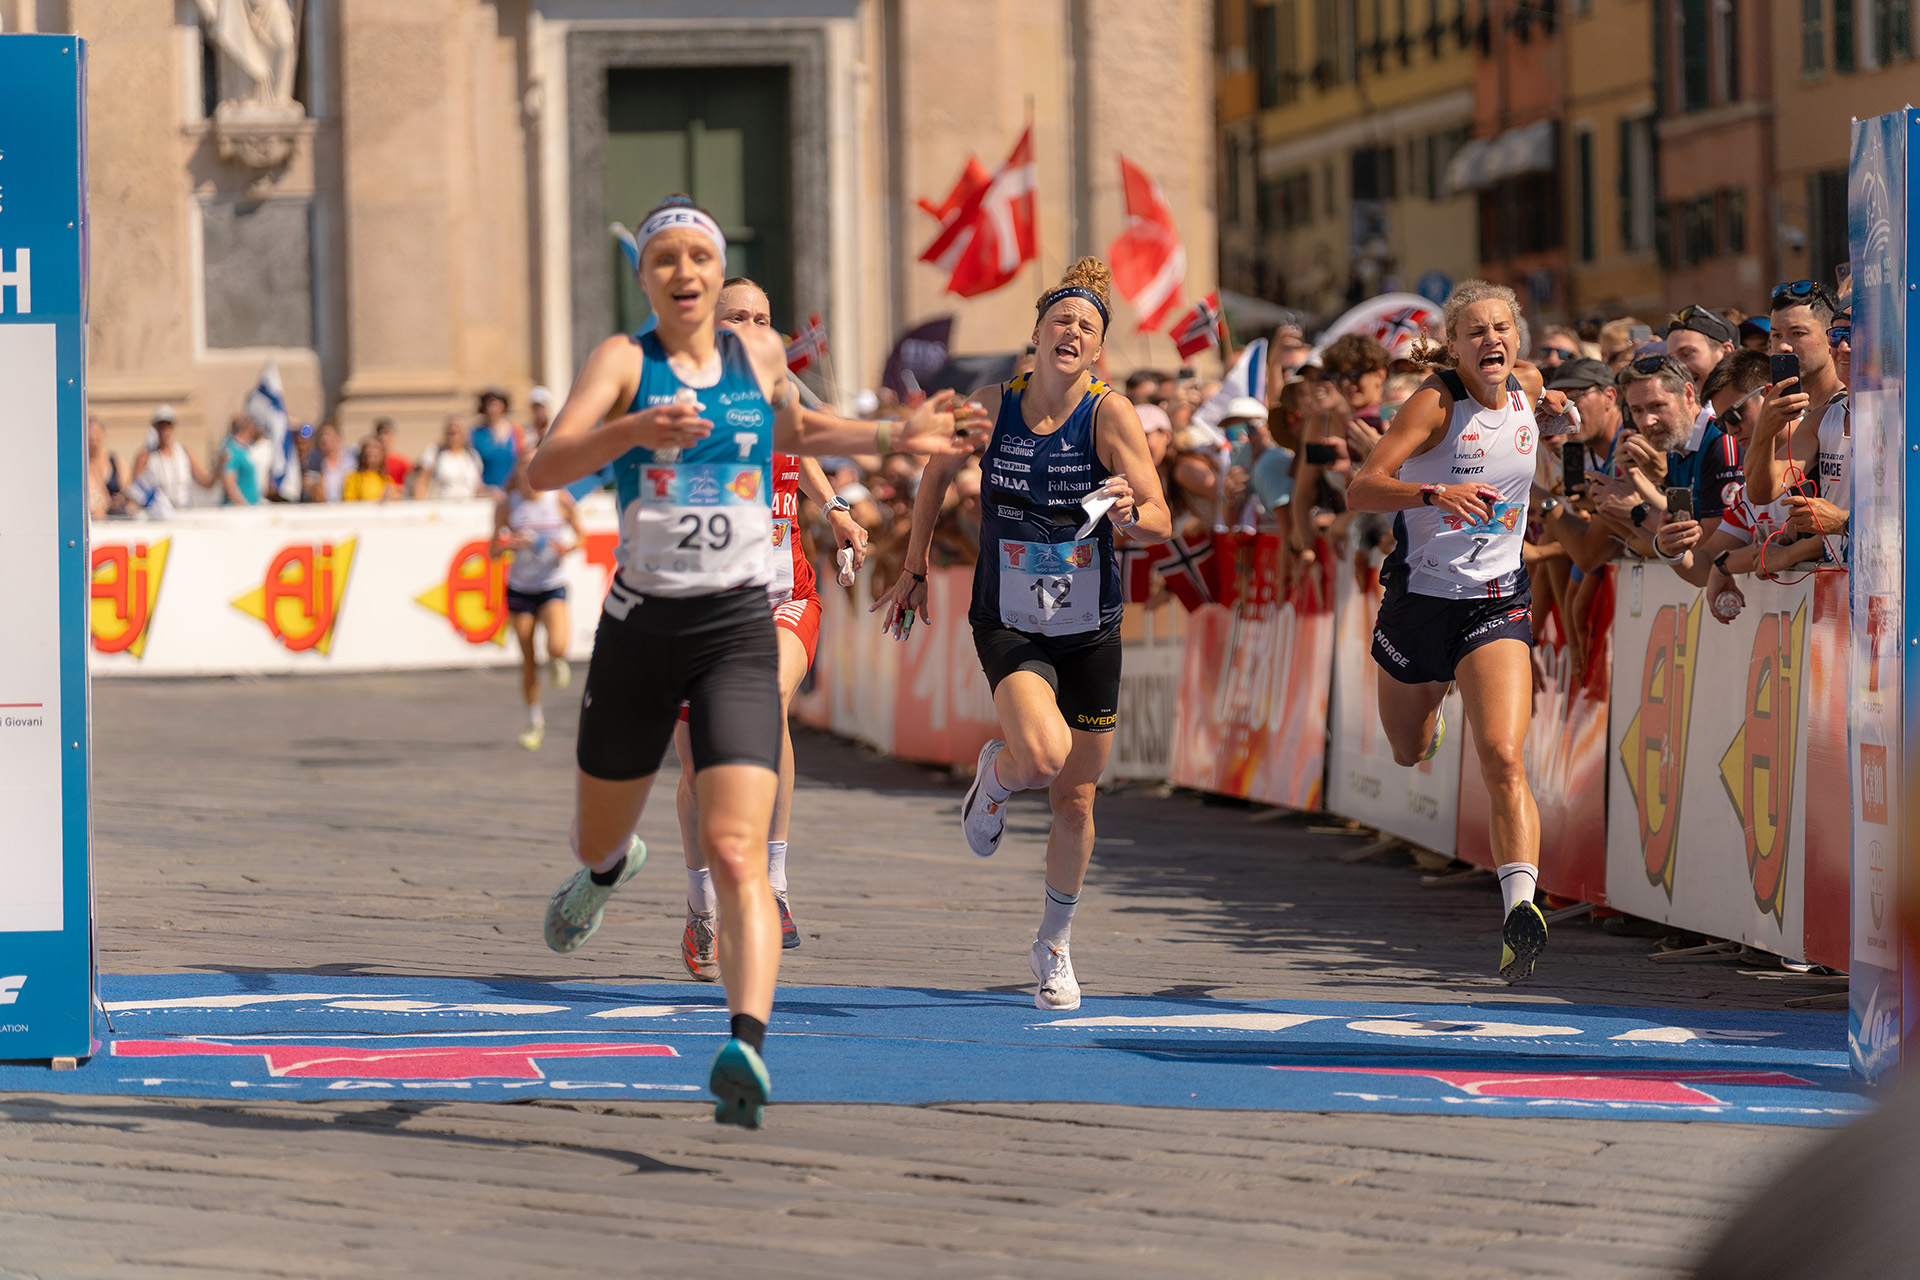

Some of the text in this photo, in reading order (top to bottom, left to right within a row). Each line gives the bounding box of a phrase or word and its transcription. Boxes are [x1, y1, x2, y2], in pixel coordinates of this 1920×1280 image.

[646, 213, 689, 234] CZE
[1451, 465, 1485, 475] TRIMTEX
[1047, 480, 1092, 492] Folksam
[677, 513, 733, 551] 29
[1472, 537, 1489, 563] 7
[1030, 578, 1072, 609] 12
[1375, 629, 1410, 668] NORGE
[5, 717, 43, 727] Giovani
[1077, 713, 1118, 725] SWEDE
